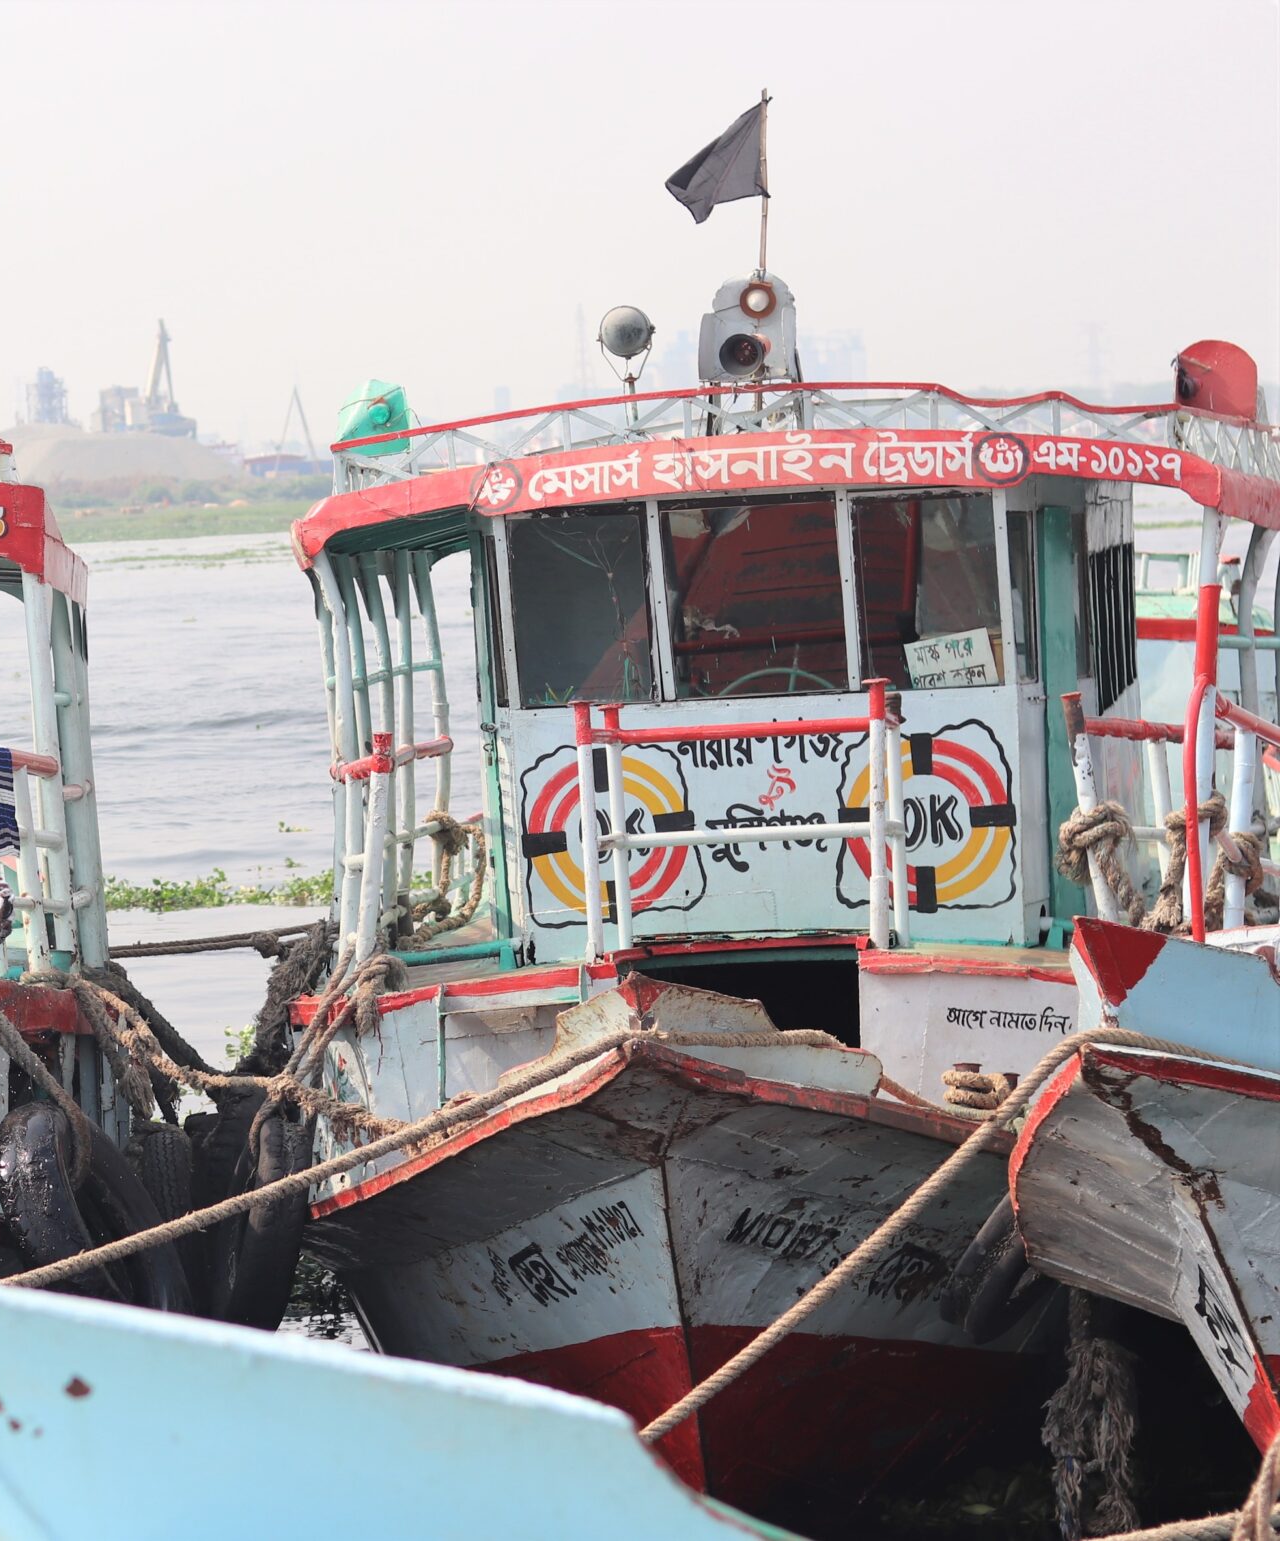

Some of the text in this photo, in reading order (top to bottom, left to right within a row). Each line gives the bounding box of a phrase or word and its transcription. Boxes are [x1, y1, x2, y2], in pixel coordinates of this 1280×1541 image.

[527, 431, 973, 501] মেসার্স হাসনাইন ট্রেডার্স
[1033, 440, 1182, 481] এম-১০১২৭
[903, 794, 964, 853] OK
[946, 1007, 988, 1030] আগে
[989, 1010, 1038, 1032] নামতে
